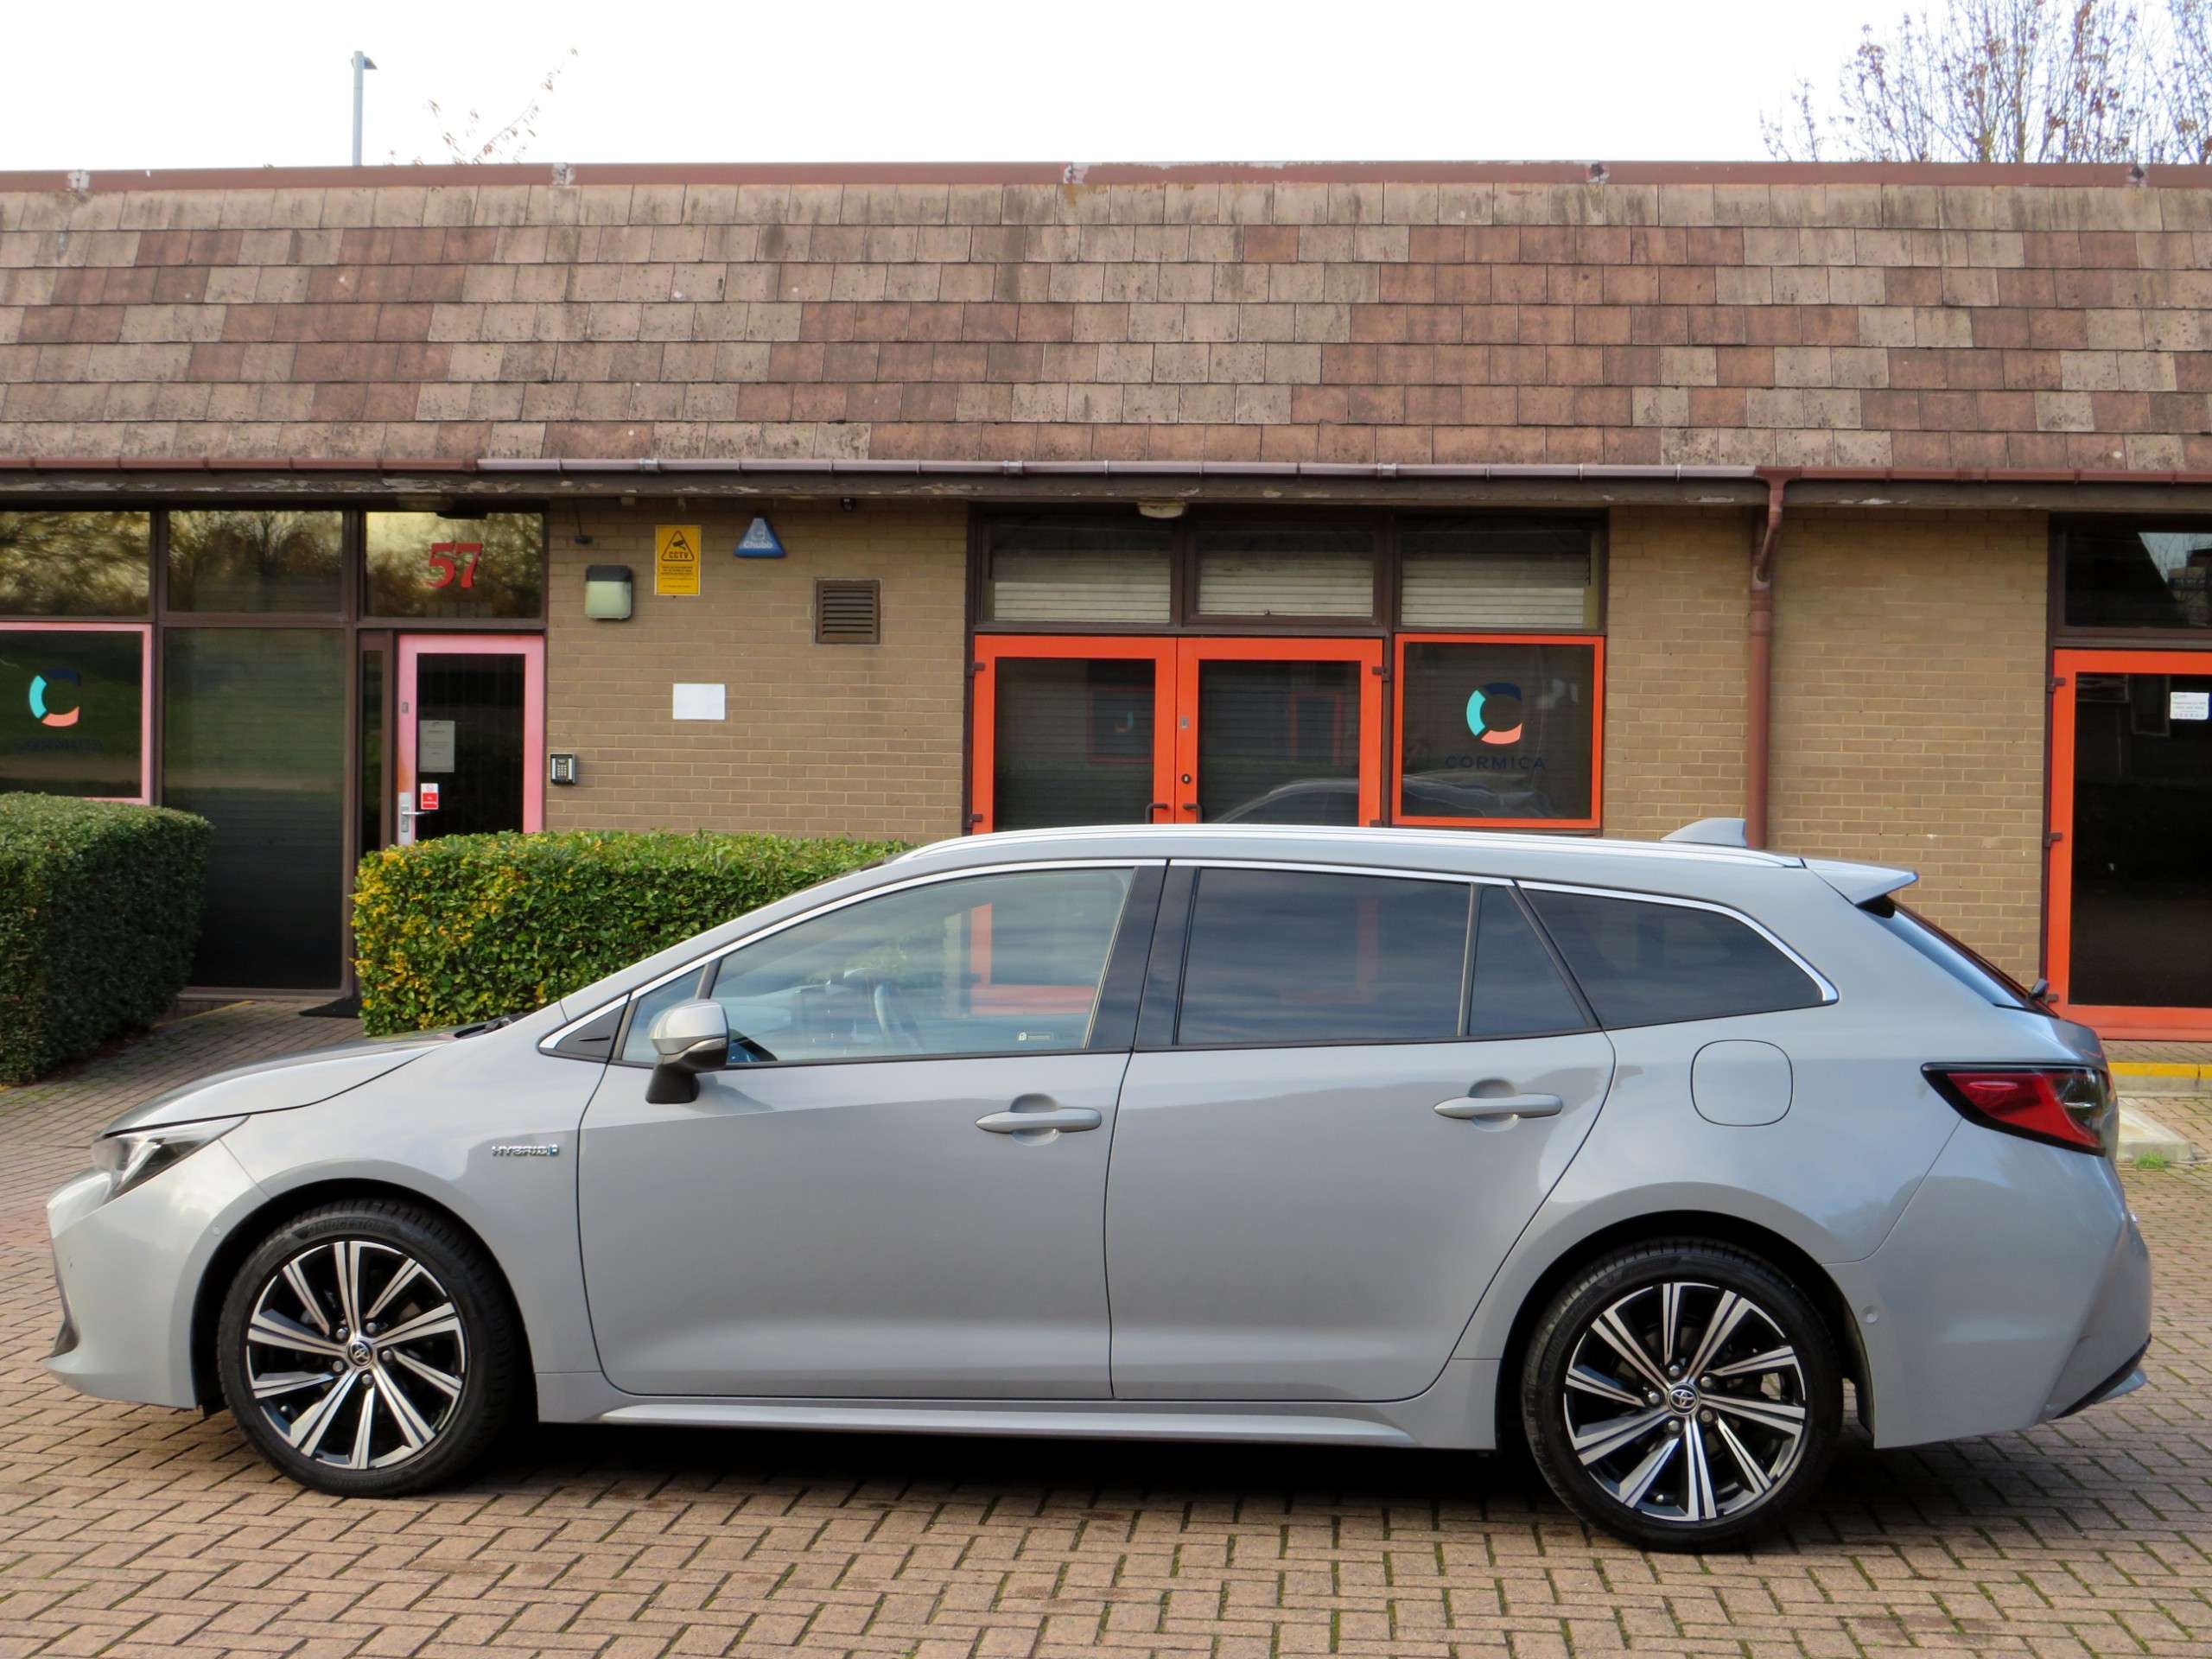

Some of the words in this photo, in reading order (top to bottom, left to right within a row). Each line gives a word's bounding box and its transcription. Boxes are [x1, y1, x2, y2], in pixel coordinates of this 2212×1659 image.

[743, 540, 774, 550] Chubb
[669, 550, 690, 559] CCTV
[429, 541, 483, 588] 57
[1446, 754, 1546, 770] CORMICA
